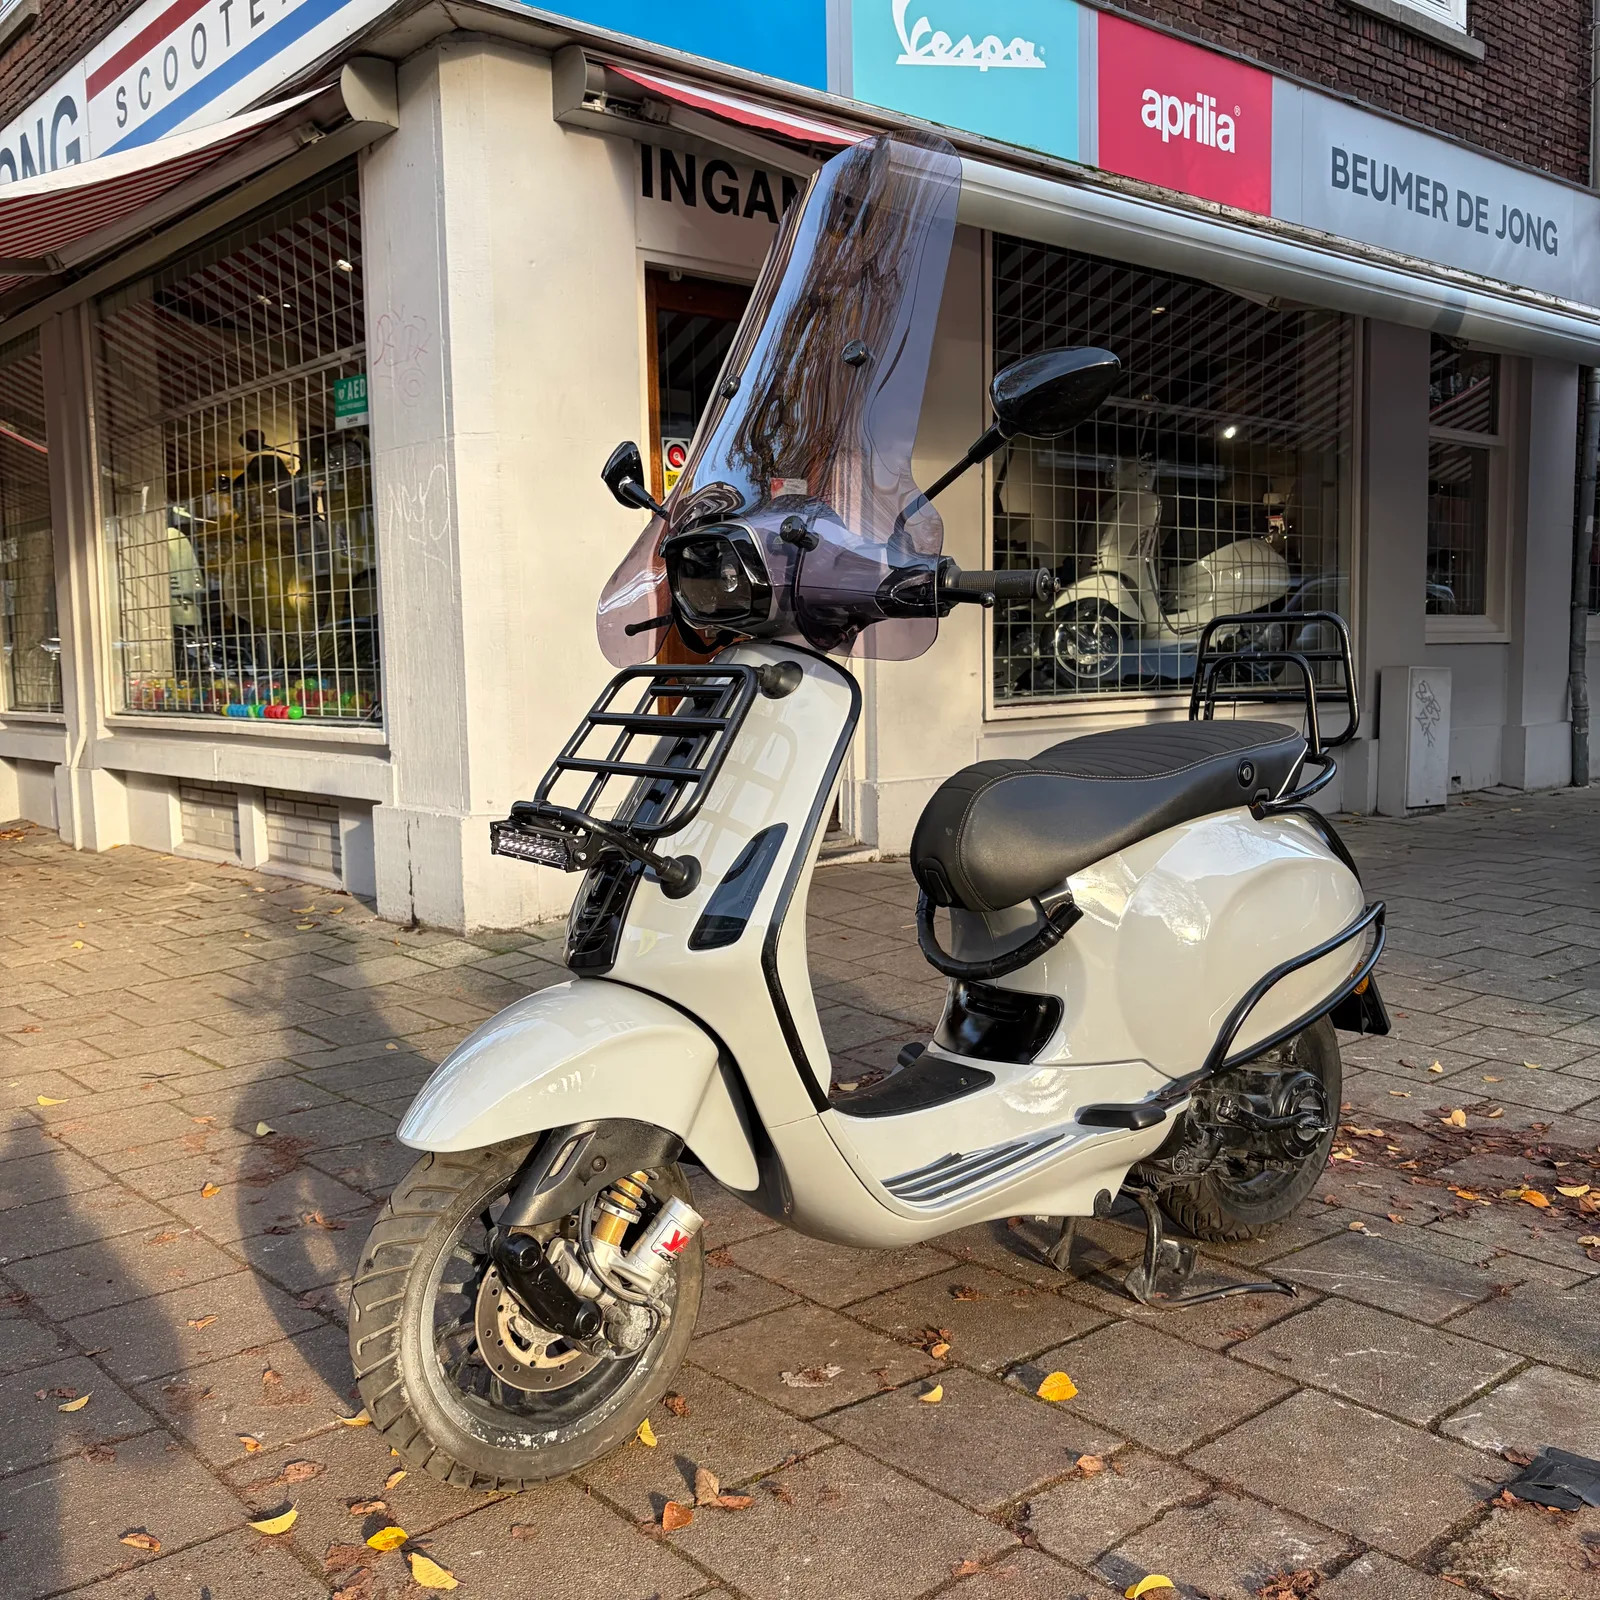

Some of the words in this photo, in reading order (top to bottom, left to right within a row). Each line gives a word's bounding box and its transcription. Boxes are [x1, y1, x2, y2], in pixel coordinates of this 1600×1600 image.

[115, 0, 287, 128] SCOOTE
[895, 0, 1047, 72] Vespa
[1141, 88, 1236, 154] aprilia
[1331, 146, 1449, 222] BEUMER
[1456, 189, 1489, 235] DE
[1494, 204, 1558, 257] JONG
[347, 378, 366, 401] AED
